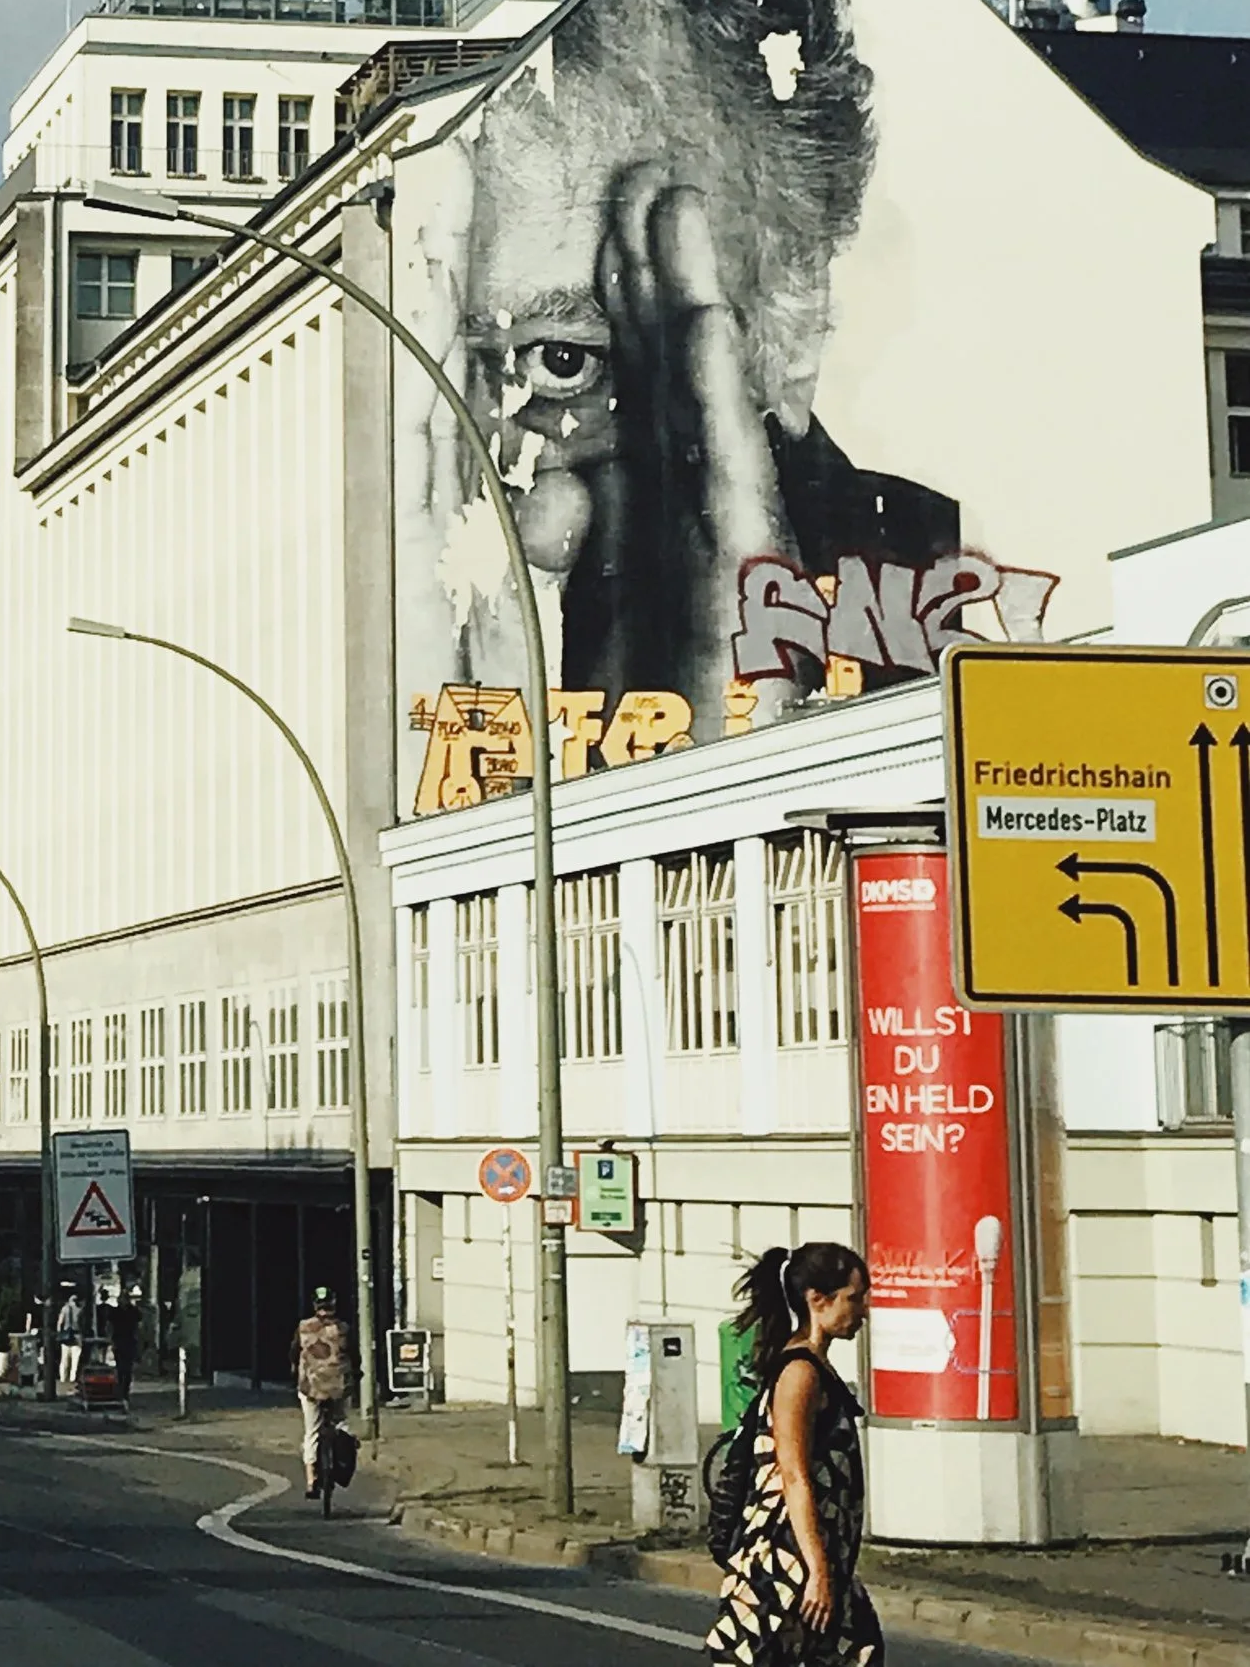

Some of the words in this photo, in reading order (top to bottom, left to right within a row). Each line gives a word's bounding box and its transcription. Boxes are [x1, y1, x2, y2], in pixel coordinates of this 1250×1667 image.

[974, 760, 1172, 789] Friedrichshain
[986, 804, 1148, 833] Mercedes-Platz
[861, 878, 911, 904] DKMS
[867, 1005, 972, 1036] WILLST
[894, 1044, 940, 1075] DU
[904, 1084, 994, 1115] HELD
[880, 1121, 966, 1153] SEIN?
